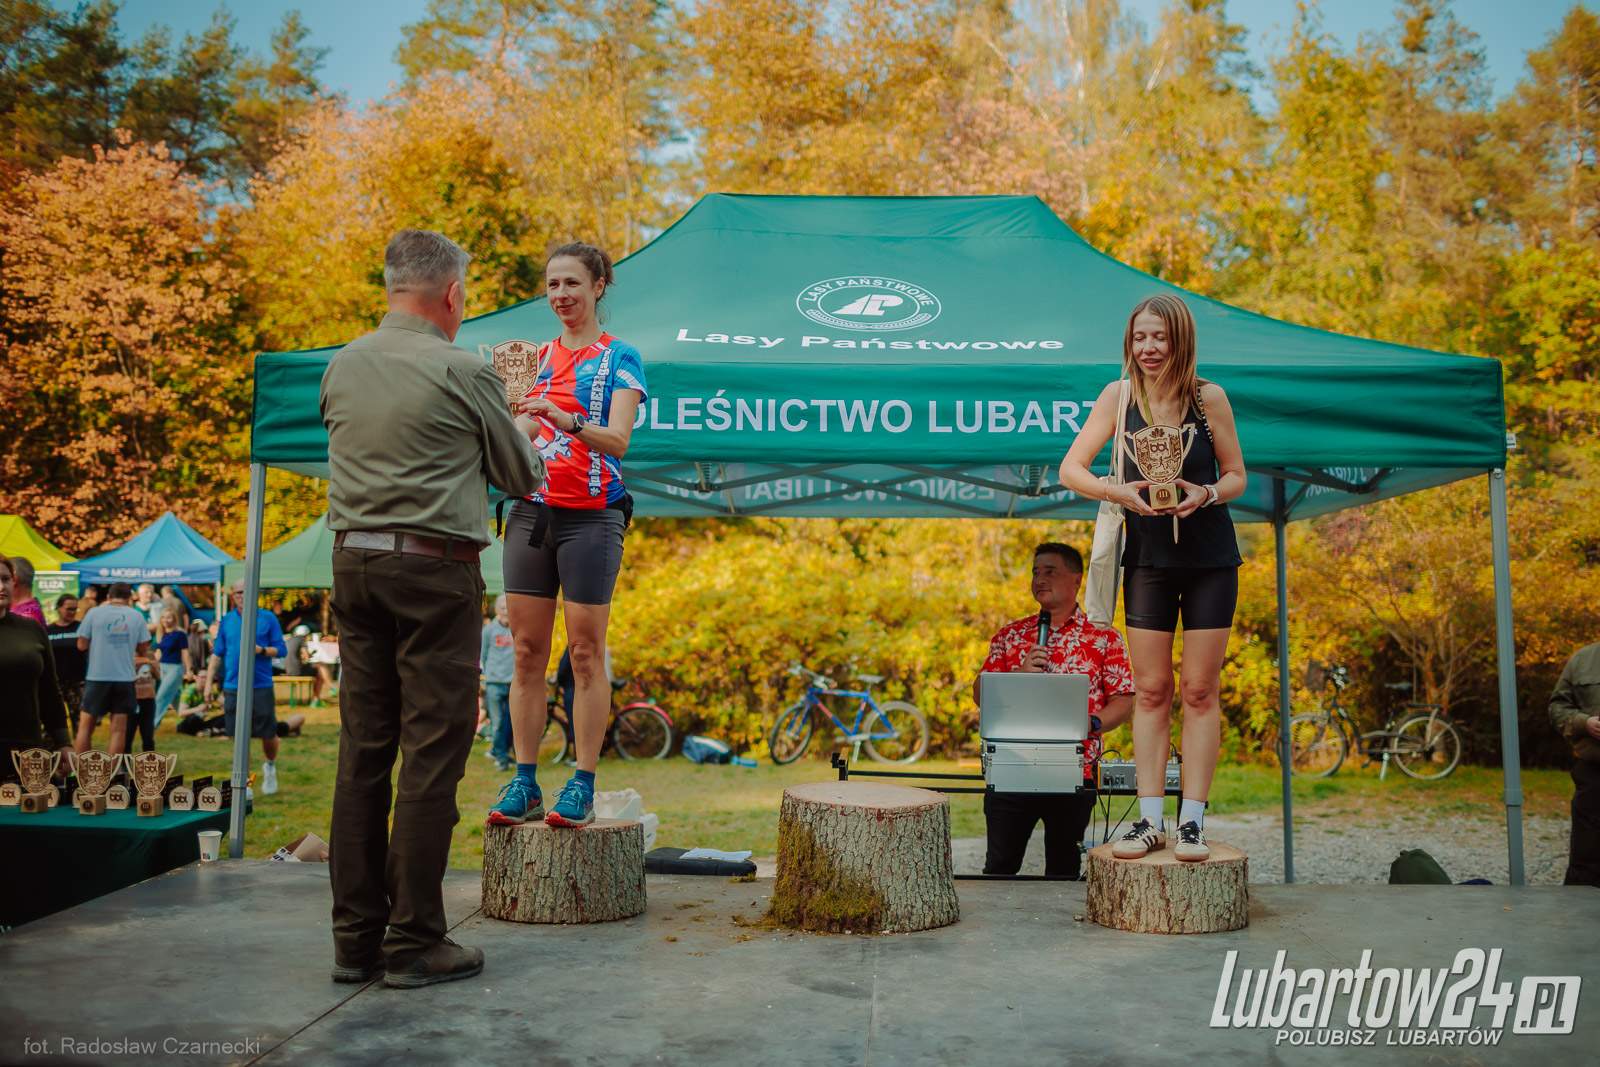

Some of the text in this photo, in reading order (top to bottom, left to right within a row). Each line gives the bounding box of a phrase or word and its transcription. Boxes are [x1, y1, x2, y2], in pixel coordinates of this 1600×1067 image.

[803, 277, 935, 306] LASY PAŃSTWOWE
[676, 328, 1064, 350] Lasy Państwowe
